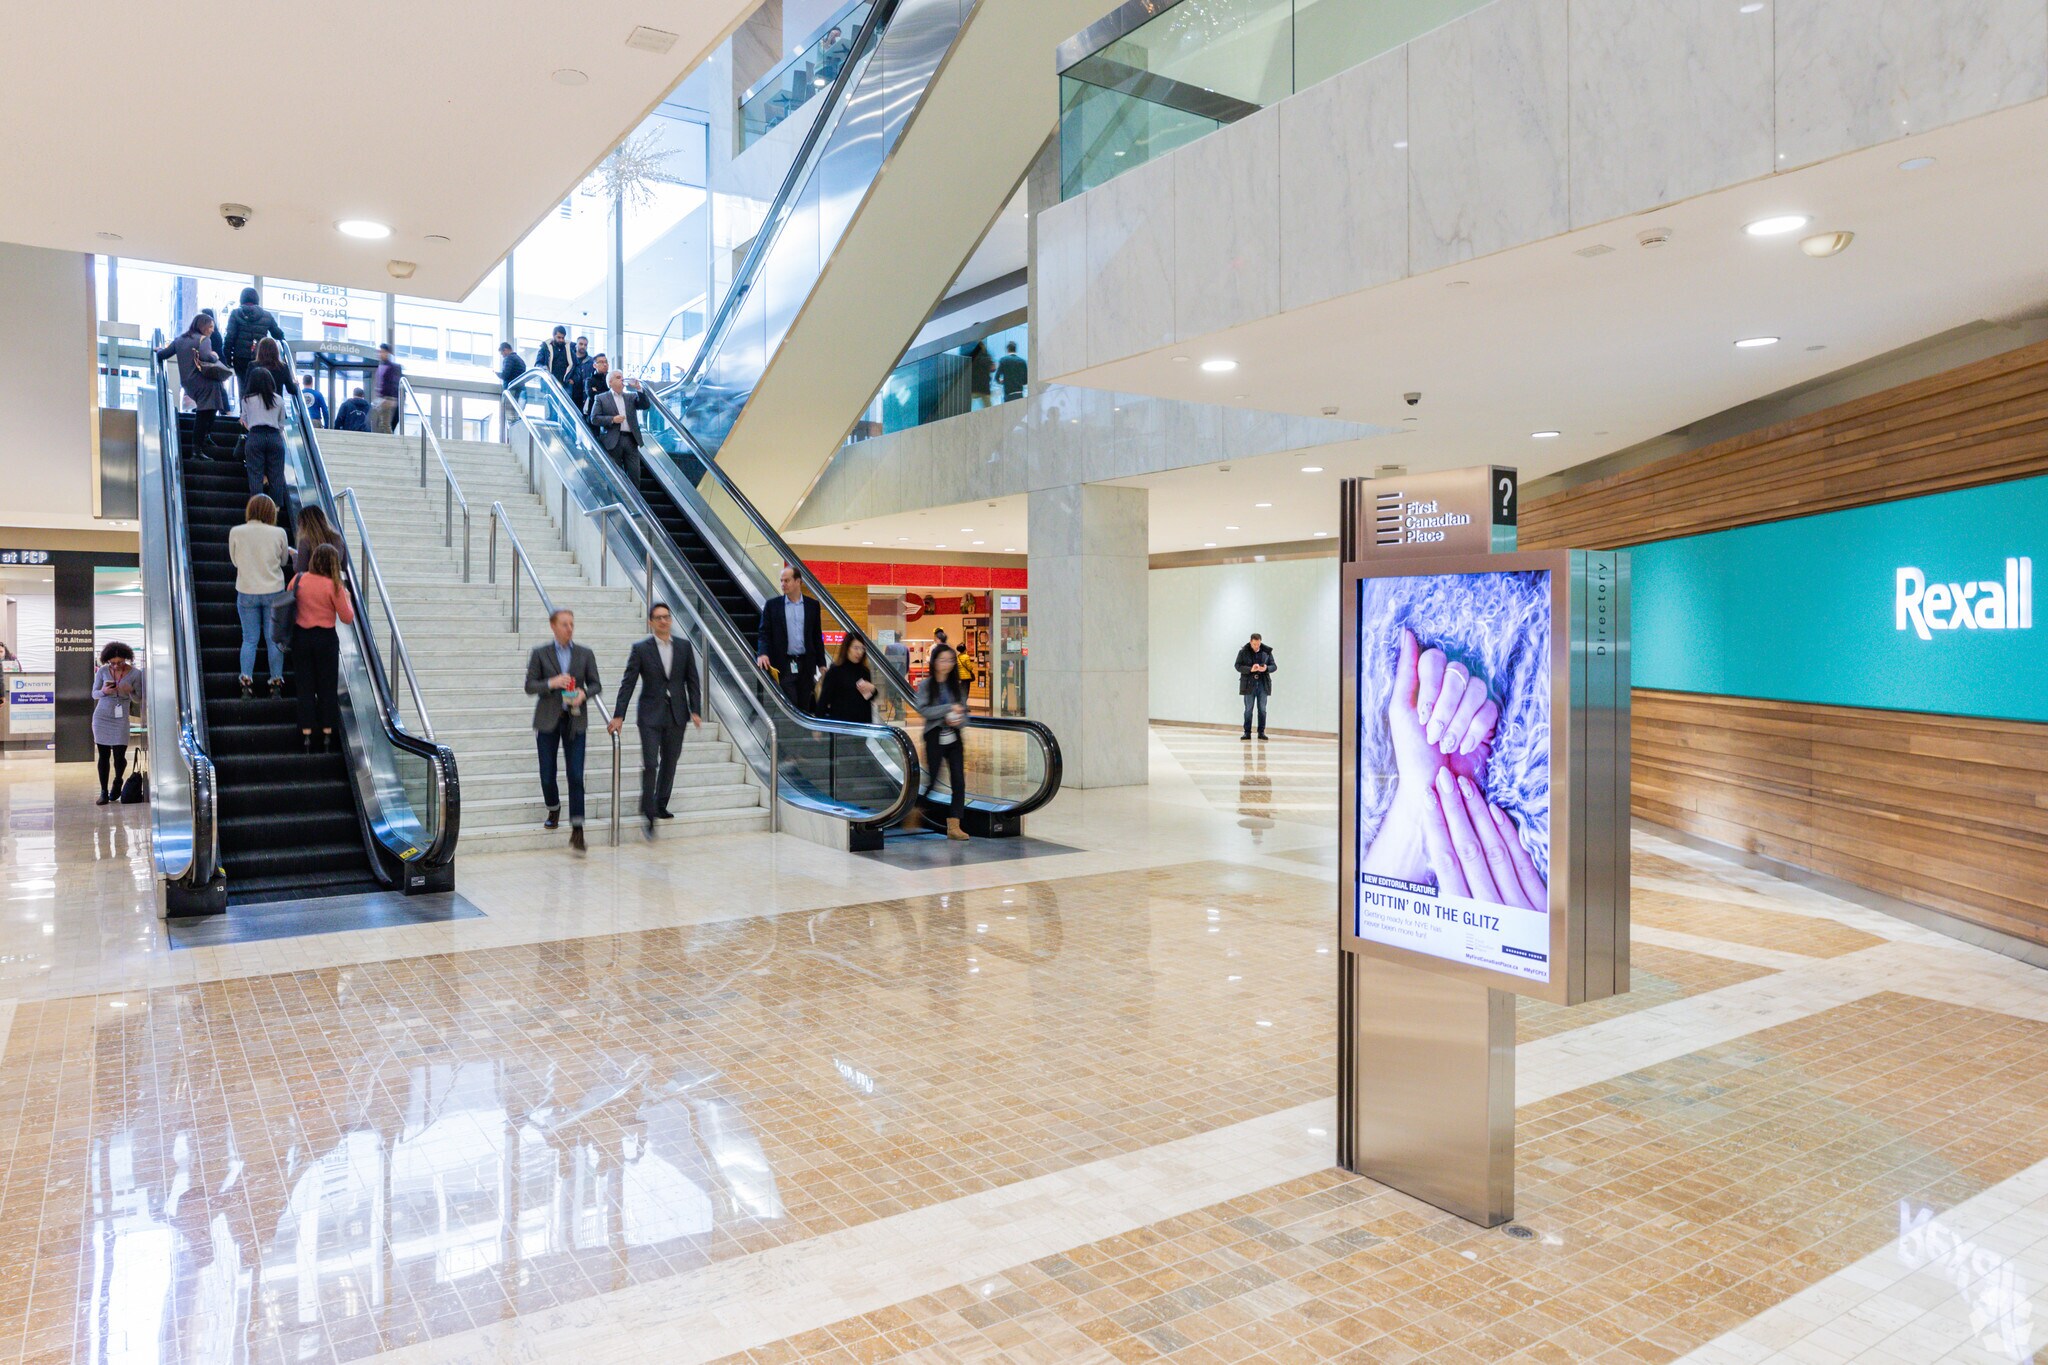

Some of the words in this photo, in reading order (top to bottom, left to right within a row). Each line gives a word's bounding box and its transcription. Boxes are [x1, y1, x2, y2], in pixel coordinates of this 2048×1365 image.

[320, 343, 360, 354] Adelaide
[1405, 500, 1437, 515] First
[1405, 513, 1470, 529] Canadian
[1405, 530, 1445, 543] Place
[2, 551, 18, 563] at
[21, 551, 48, 563] FCP
[1896, 556, 2032, 640] Rexall
[1596, 562, 1608, 656] Directory
[1364, 874, 1378, 883] NEW
[1379, 877, 1409, 890] EDITORIAL
[1409, 883, 1436, 896] FEATURE
[1413, 901, 1430, 916] ON
[1435, 905, 1459, 922] THE
[1463, 911, 1500, 932] GLITZ
[1415, 920, 1428, 930] NYE
